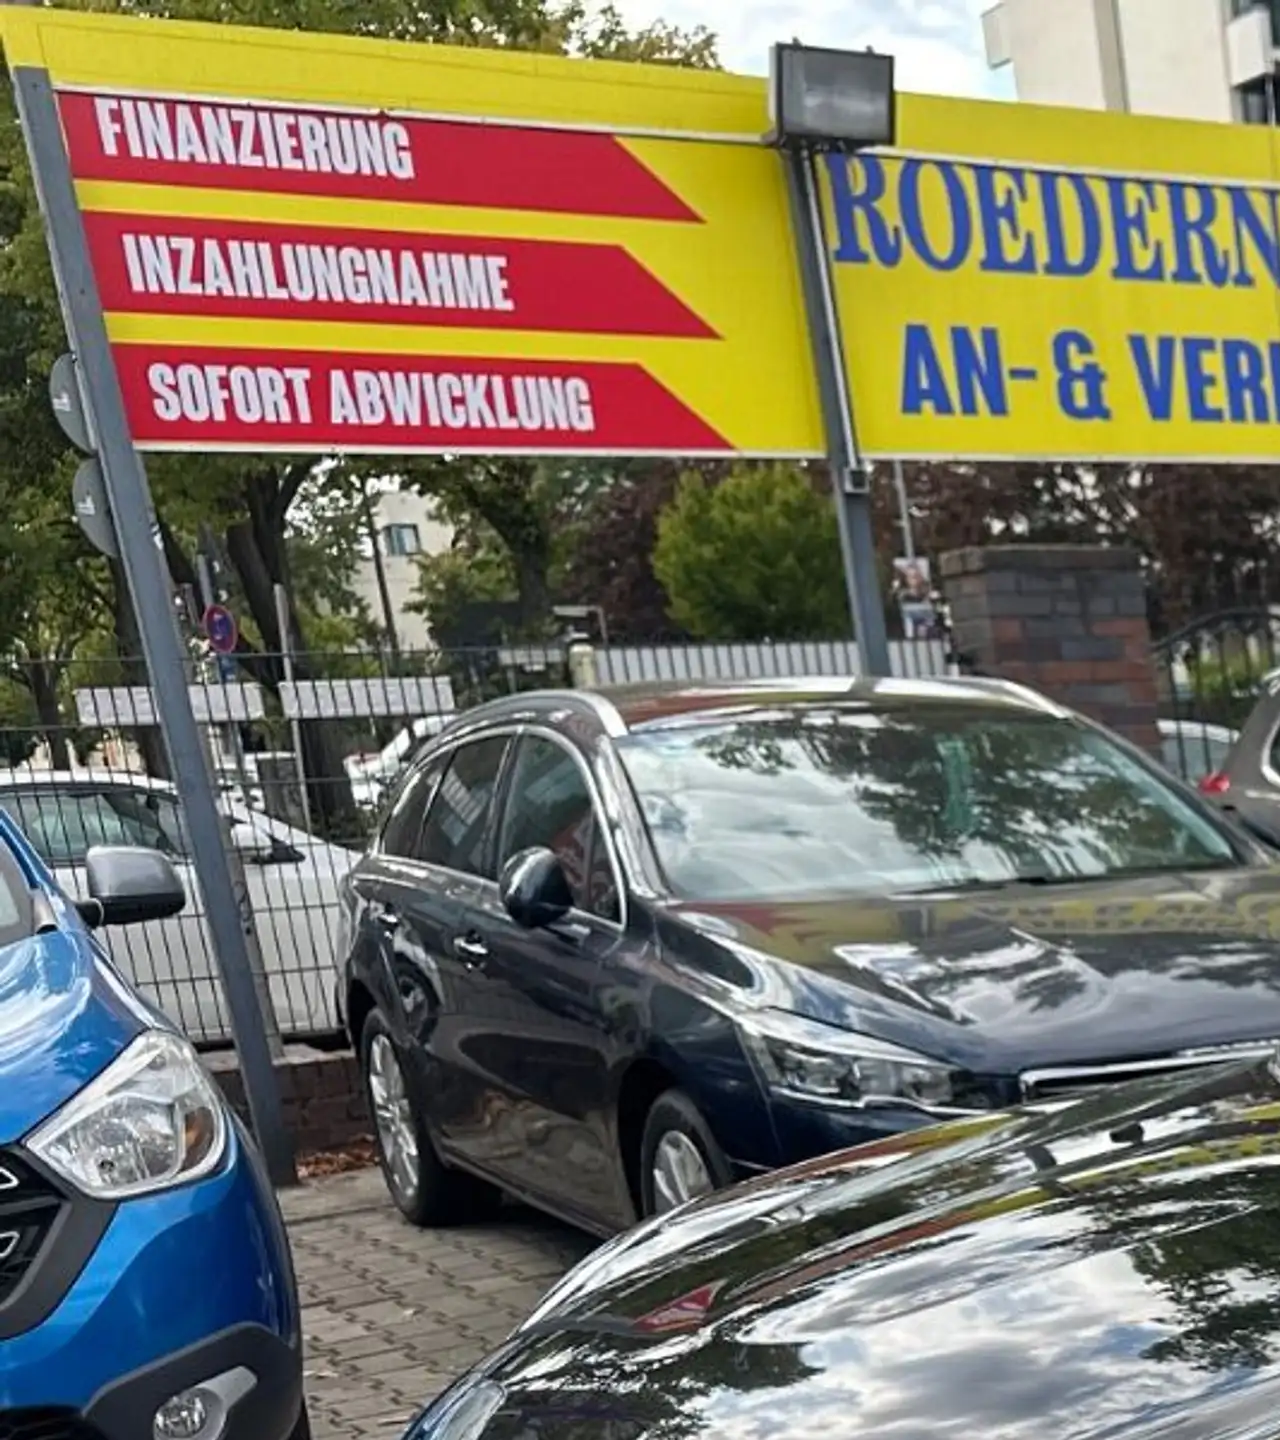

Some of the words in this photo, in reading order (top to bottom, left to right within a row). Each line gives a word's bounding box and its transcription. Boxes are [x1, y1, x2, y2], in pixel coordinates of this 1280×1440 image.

[94, 97, 414, 179] FINANZIERUNG
[122, 233, 515, 312] INZAHLUNGNAHME
[148, 363, 311, 424] SOFORT
[329, 367, 595, 432] ABWICKLUNG
[1052, 330, 1112, 421] &
